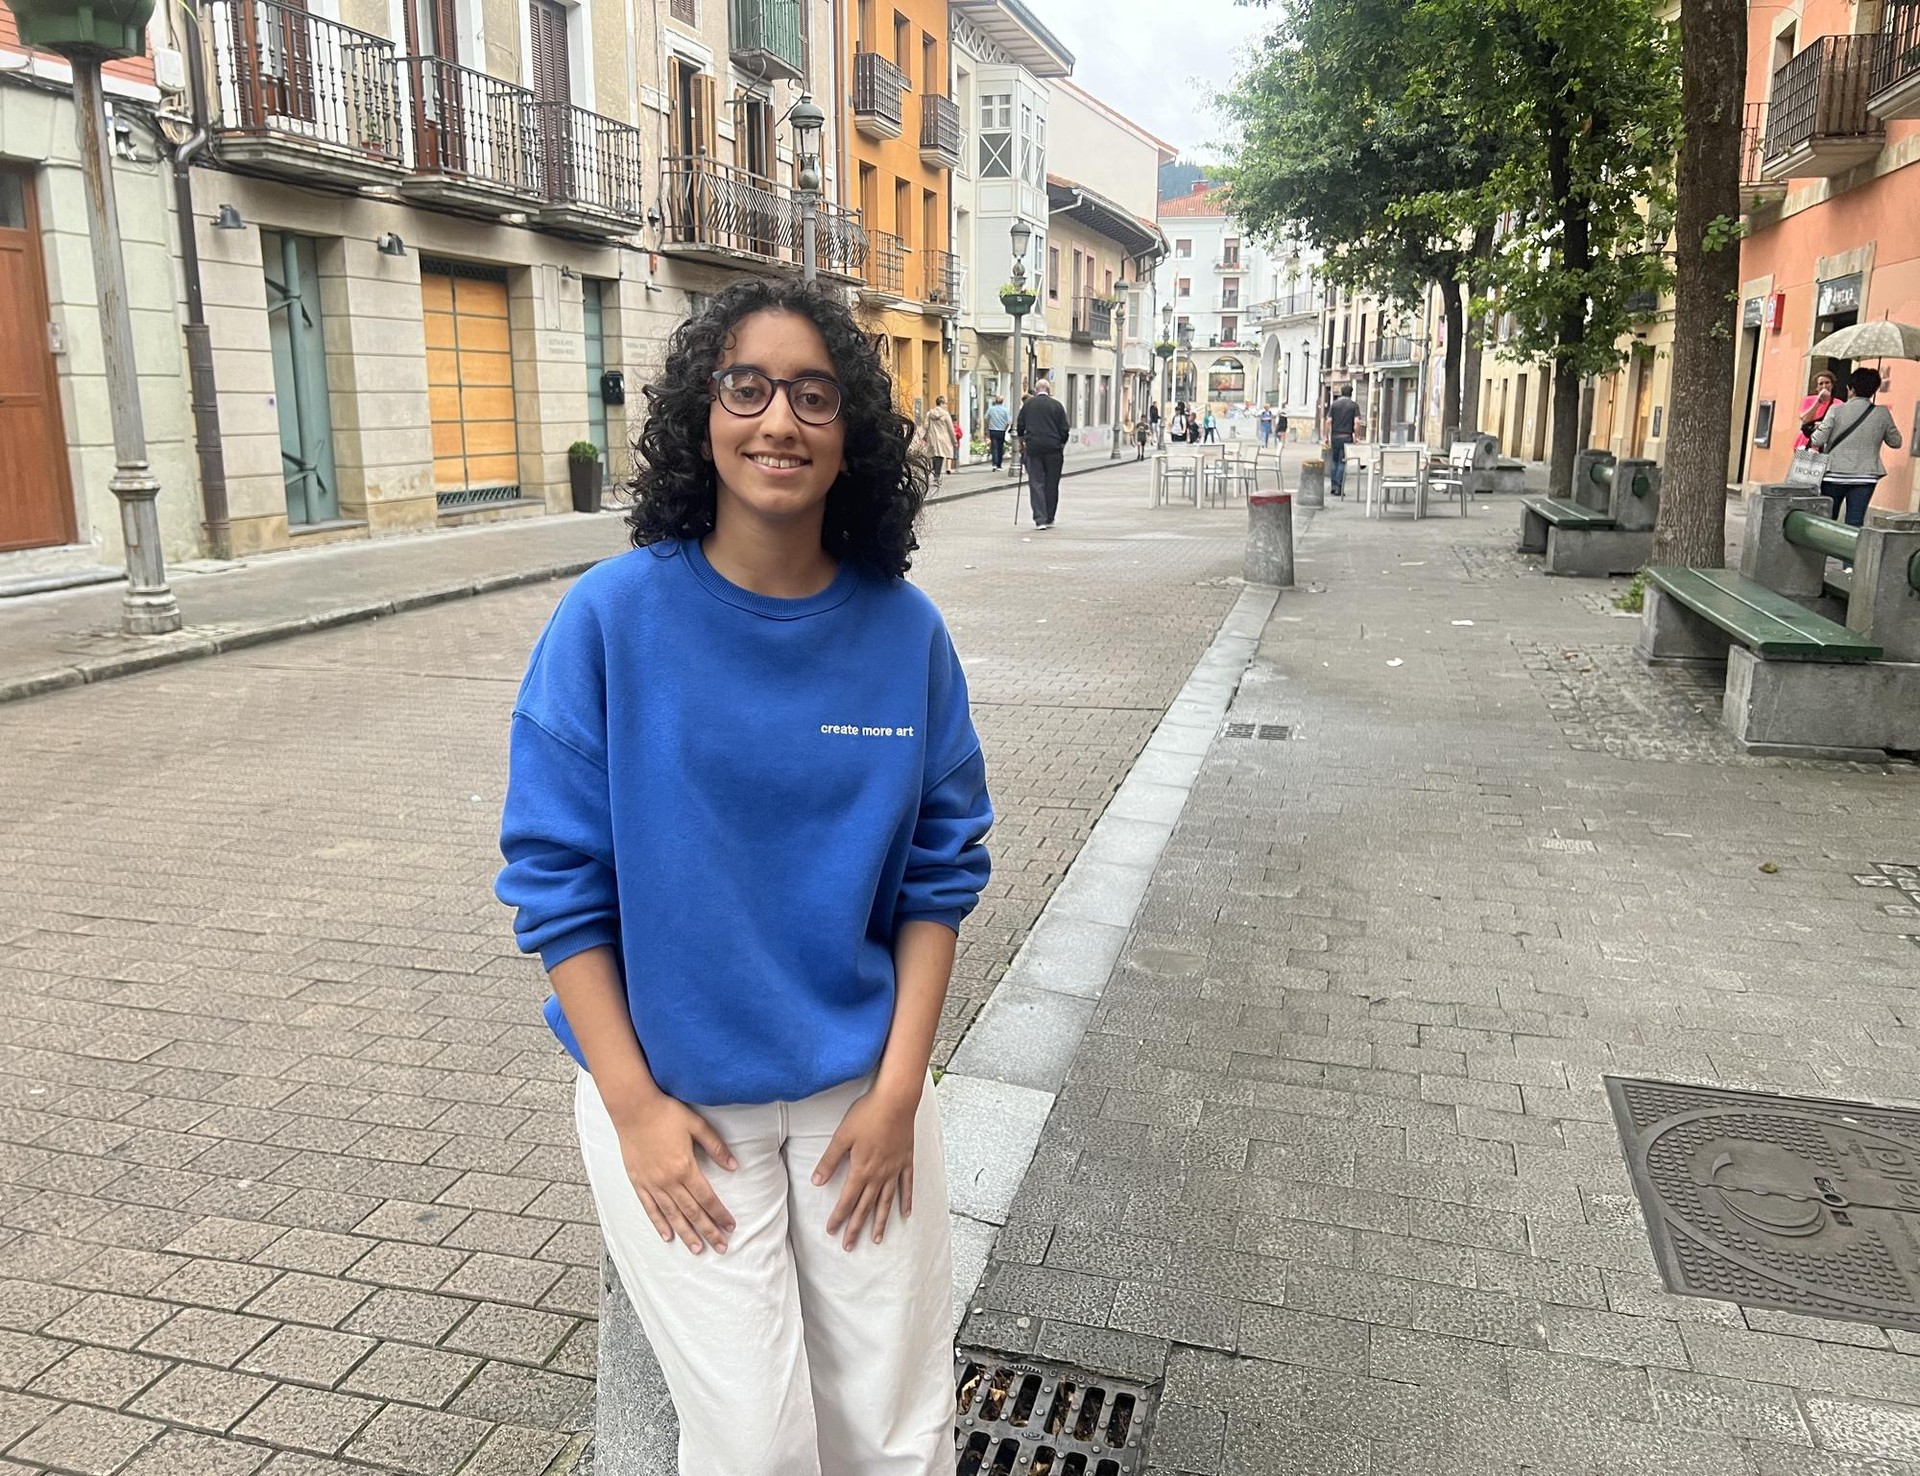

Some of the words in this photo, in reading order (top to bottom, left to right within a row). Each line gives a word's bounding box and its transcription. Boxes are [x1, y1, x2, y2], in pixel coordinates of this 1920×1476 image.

[821, 724, 859, 736] create
[862, 726, 893, 737] more
[896, 726, 914, 737] art
